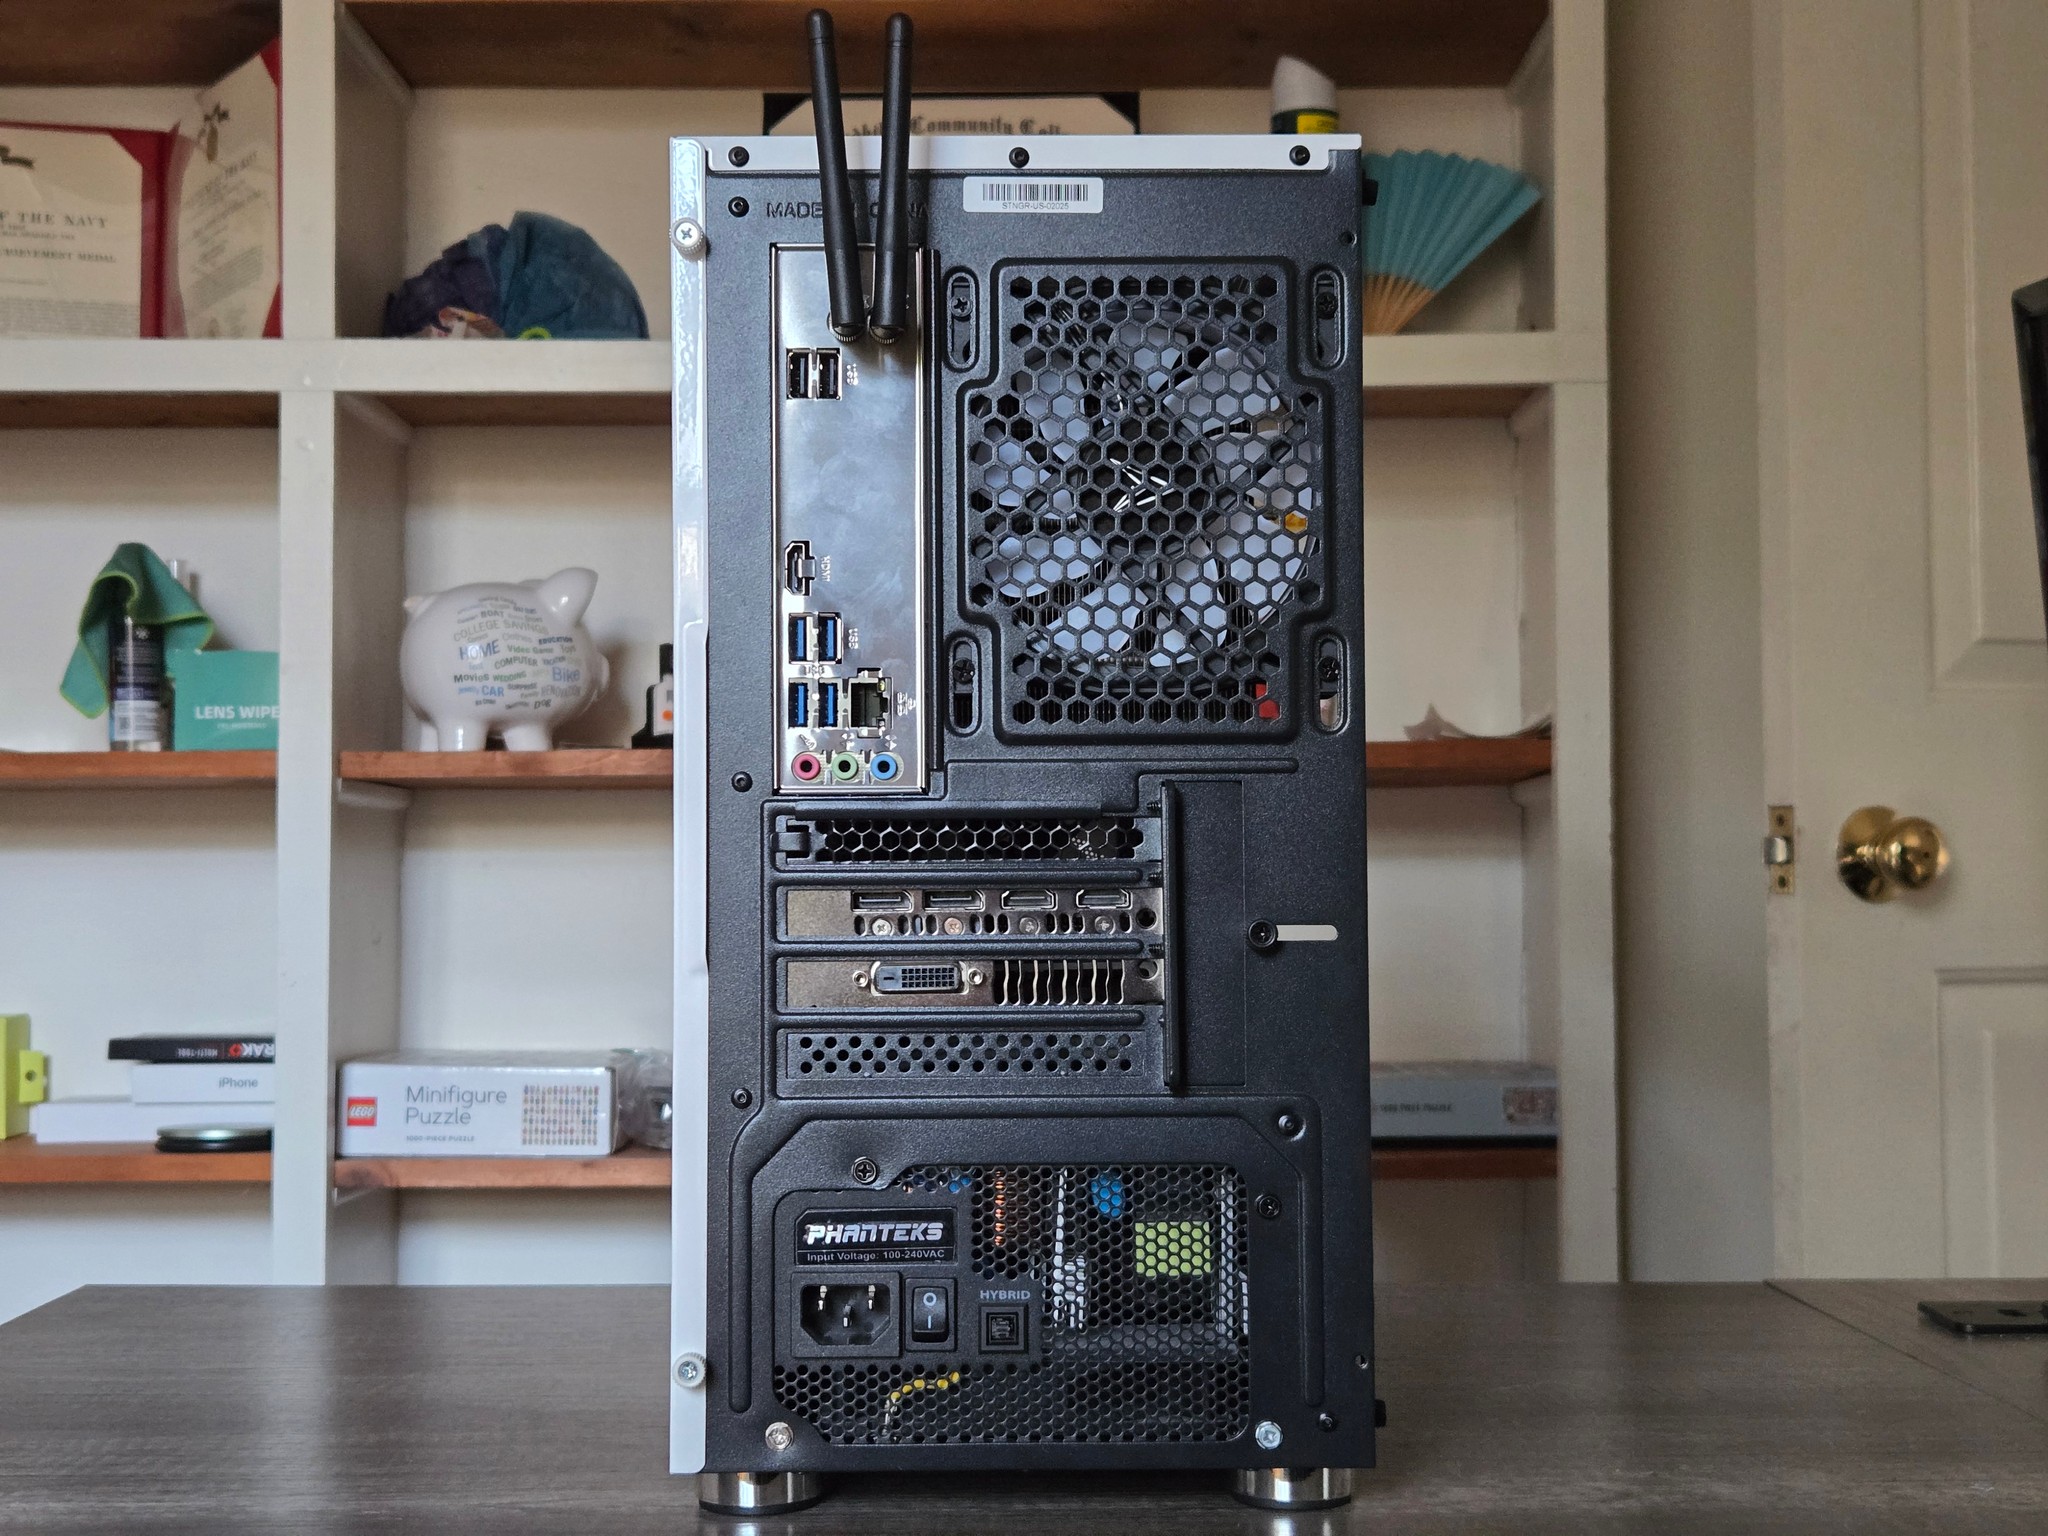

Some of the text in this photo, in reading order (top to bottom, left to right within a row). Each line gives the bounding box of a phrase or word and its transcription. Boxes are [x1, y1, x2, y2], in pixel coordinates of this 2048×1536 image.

[766, 202, 823, 219] MADE
[1002, 201, 1070, 210] STNGR-US-02025
[63, 213, 108, 229] NAVY
[459, 640, 500, 661] HOME
[494, 656, 539, 670] COMPUTER
[453, 673, 490, 683] Movies
[552, 666, 580, 683] Bike
[481, 685, 505, 697] CAR
[195, 706, 235, 720] LENS
[218, 1077, 259, 1089] iPhone
[406, 1085, 508, 1109] Minifigure
[350, 1106, 376, 1117] LEGO
[405, 1106, 472, 1125] Puzzle
[806, 1222, 944, 1245] PHANTEKS
[807, 1249, 945, 1263] Input Voltage: 100-240VAC
[980, 1289, 1030, 1300] HYBRID
